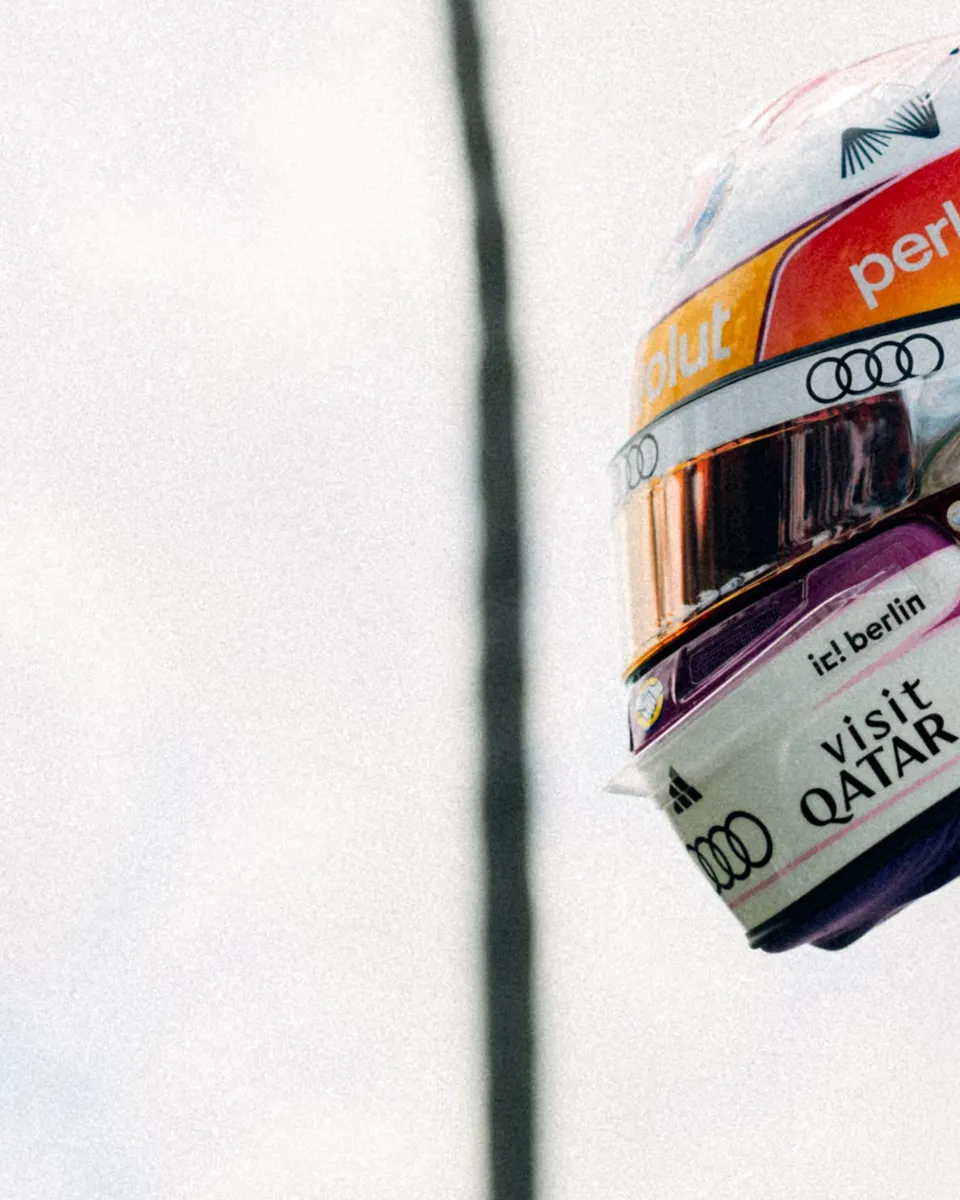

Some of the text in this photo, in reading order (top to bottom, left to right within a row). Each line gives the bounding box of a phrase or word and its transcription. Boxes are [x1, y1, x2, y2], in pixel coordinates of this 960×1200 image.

[641, 300, 732, 404] olut
[843, 593, 927, 654] berlin
[819, 677, 933, 765] visit
[799, 712, 960, 828] QATAR
